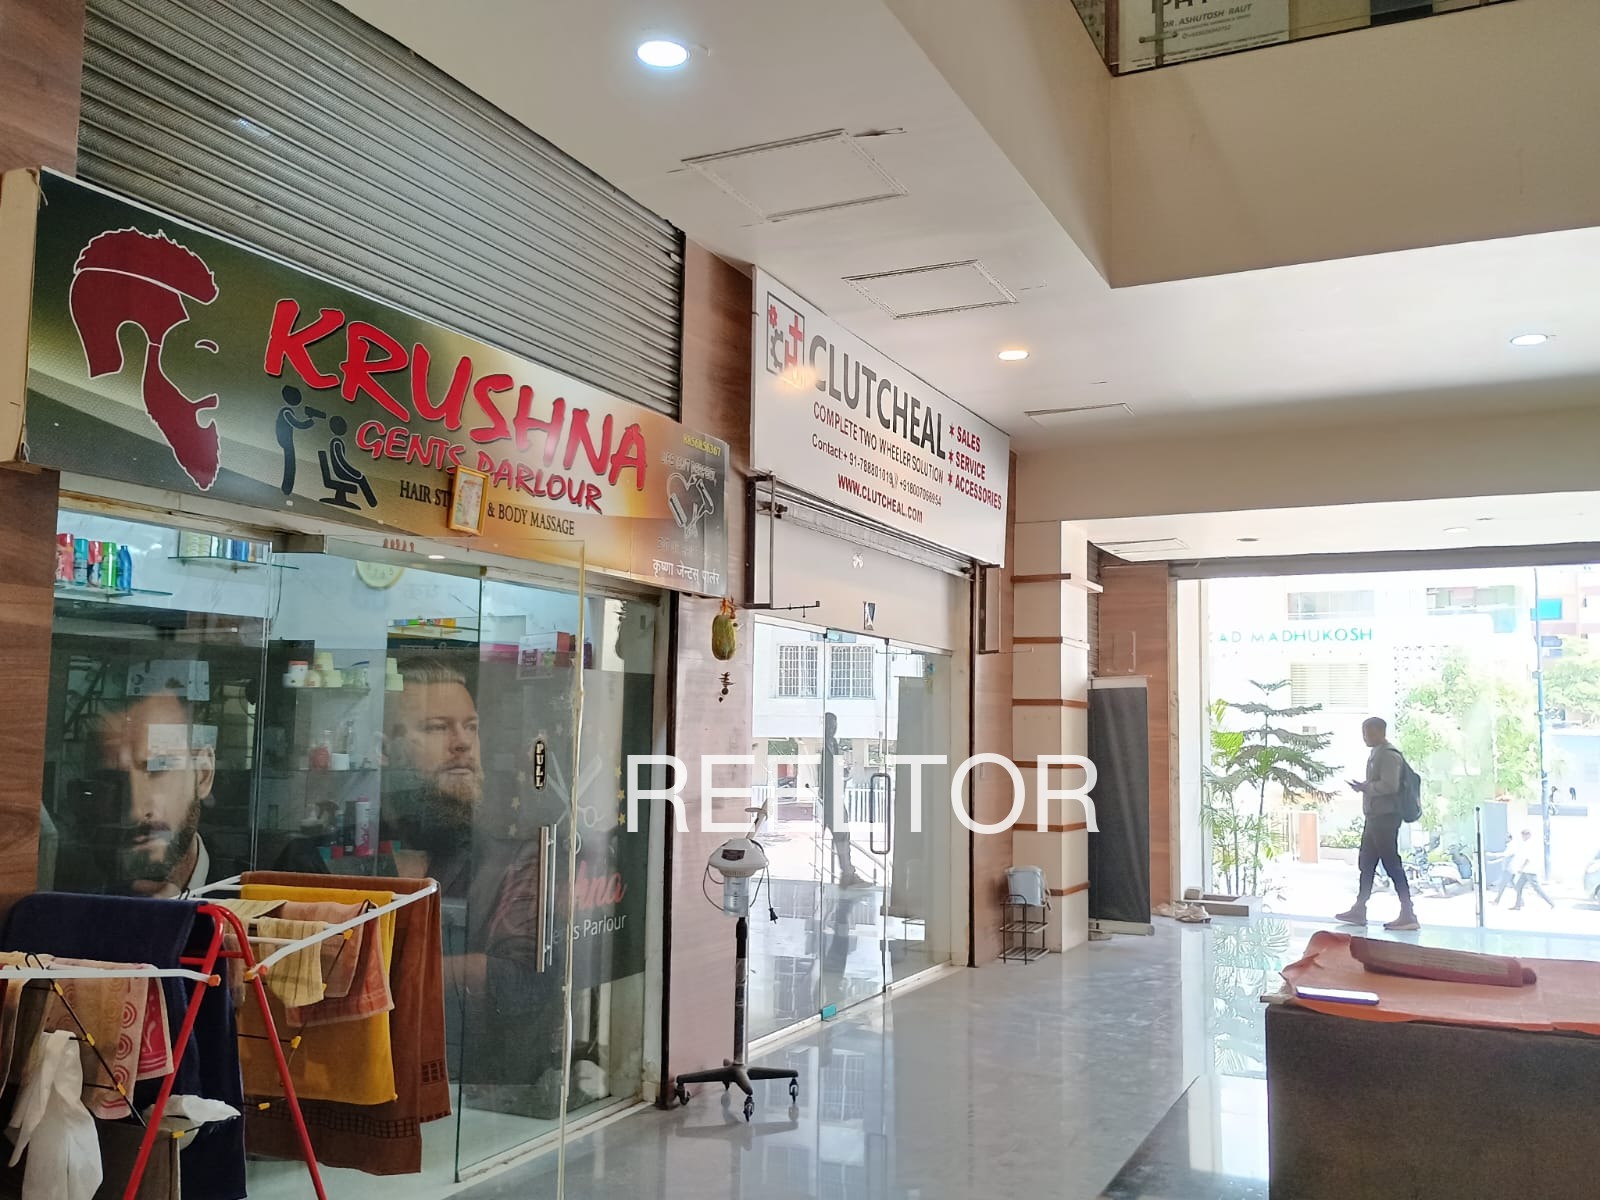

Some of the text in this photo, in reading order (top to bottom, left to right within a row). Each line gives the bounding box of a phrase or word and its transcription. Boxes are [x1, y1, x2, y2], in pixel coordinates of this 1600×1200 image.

[1179, 9, 1225, 25] ASHUTOSH
[1228, 4, 1253, 16] RAUT
[264, 298, 648, 491] KRUSHNA
[809, 335, 946, 460] CLUTCHEAL
[813, 401, 944, 484] COMPLETE TWO WHEELER SOLUTION
[957, 426, 980, 453] SALES
[355, 420, 466, 474] GENTS
[476, 450, 603, 515] PARLOUR
[956, 451, 986, 480] SERVICE
[400, 480, 432, 504] HAIR
[487, 502, 496, 518] &
[499, 503, 529, 526] BODY
[530, 515, 575, 535] MASSAGE
[838, 473, 923, 524] WWW.CLUTCHEAL.COM
[955, 475, 1002, 510] ACCESSORIES
[1250, 627, 1373, 643] MADHUKOSH
[535, 743, 545, 788] PULL
[583, 914, 627, 938] Parlour
